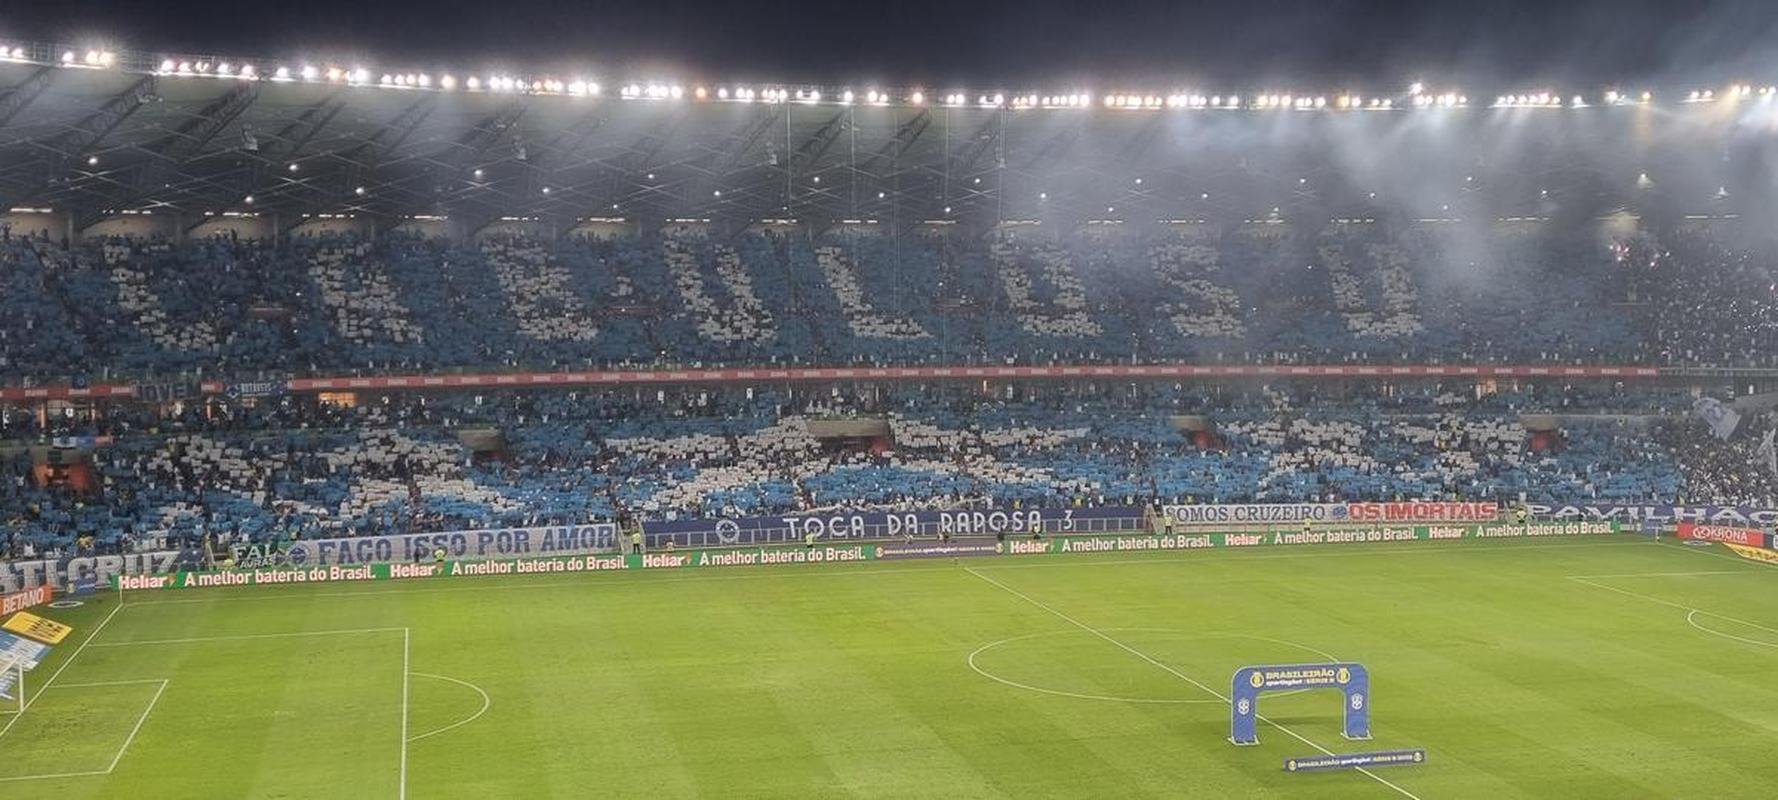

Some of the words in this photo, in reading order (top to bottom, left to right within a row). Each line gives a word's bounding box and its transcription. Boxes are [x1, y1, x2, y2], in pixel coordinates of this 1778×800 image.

[1165, 506, 1229, 522] SOMOS
[1235, 505, 1325, 521] CRUZEIRO
[1350, 503, 1379, 520] OS
[1385, 502, 1498, 520] IMORTAIS
[783, 515, 865, 539] TOCA
[887, 513, 918, 535] DA
[941, 510, 1041, 533] RAPOSA
[1063, 509, 1074, 530] 3
[1429, 526, 1464, 539] Heliar
[1475, 525, 1484, 537] A
[1485, 524, 1524, 536] melhor
[1526, 523, 1564, 536] bateria
[1565, 523, 1578, 535] do
[1580, 522, 1614, 535] Brasil.
[403, 535, 467, 560] ISSO
[477, 530, 531, 556] POR
[543, 526, 614, 551] AMOR
[1062, 539, 1071, 552] A
[1074, 537, 1115, 551] melhor
[1117, 536, 1158, 550] bateria
[1161, 536, 1175, 548] do
[1177, 535, 1214, 548] Brasil.
[1225, 534, 1261, 546] Heliar
[1274, 532, 1283, 544] A
[1284, 531, 1325, 544] melhor
[1327, 528, 1366, 543] bateria
[1367, 528, 1381, 541] do
[1384, 527, 1418, 540] Brasil.
[1010, 540, 1048, 554] Heliar
[643, 554, 684, 567] Heliar
[700, 553, 709, 566] A
[712, 551, 757, 565] melhor
[761, 550, 804, 563] bateria
[808, 548, 823, 561] do
[826, 547, 866, 561] Brasil.
[390, 563, 434, 578] Heliar
[451, 562, 462, 575] A
[465, 560, 513, 574] melhor
[517, 559, 563, 573] bateria
[567, 557, 584, 571] do
[587, 556, 629, 570] Brasil.
[118, 576, 167, 589] Heliar
[184, 573, 194, 586] A
[199, 571, 250, 586] melhor
[255, 568, 306, 583] bateria
[309, 567, 327, 581] do
[330, 566, 376, 580] Brasil.
[3, 588, 44, 614] BETANO
